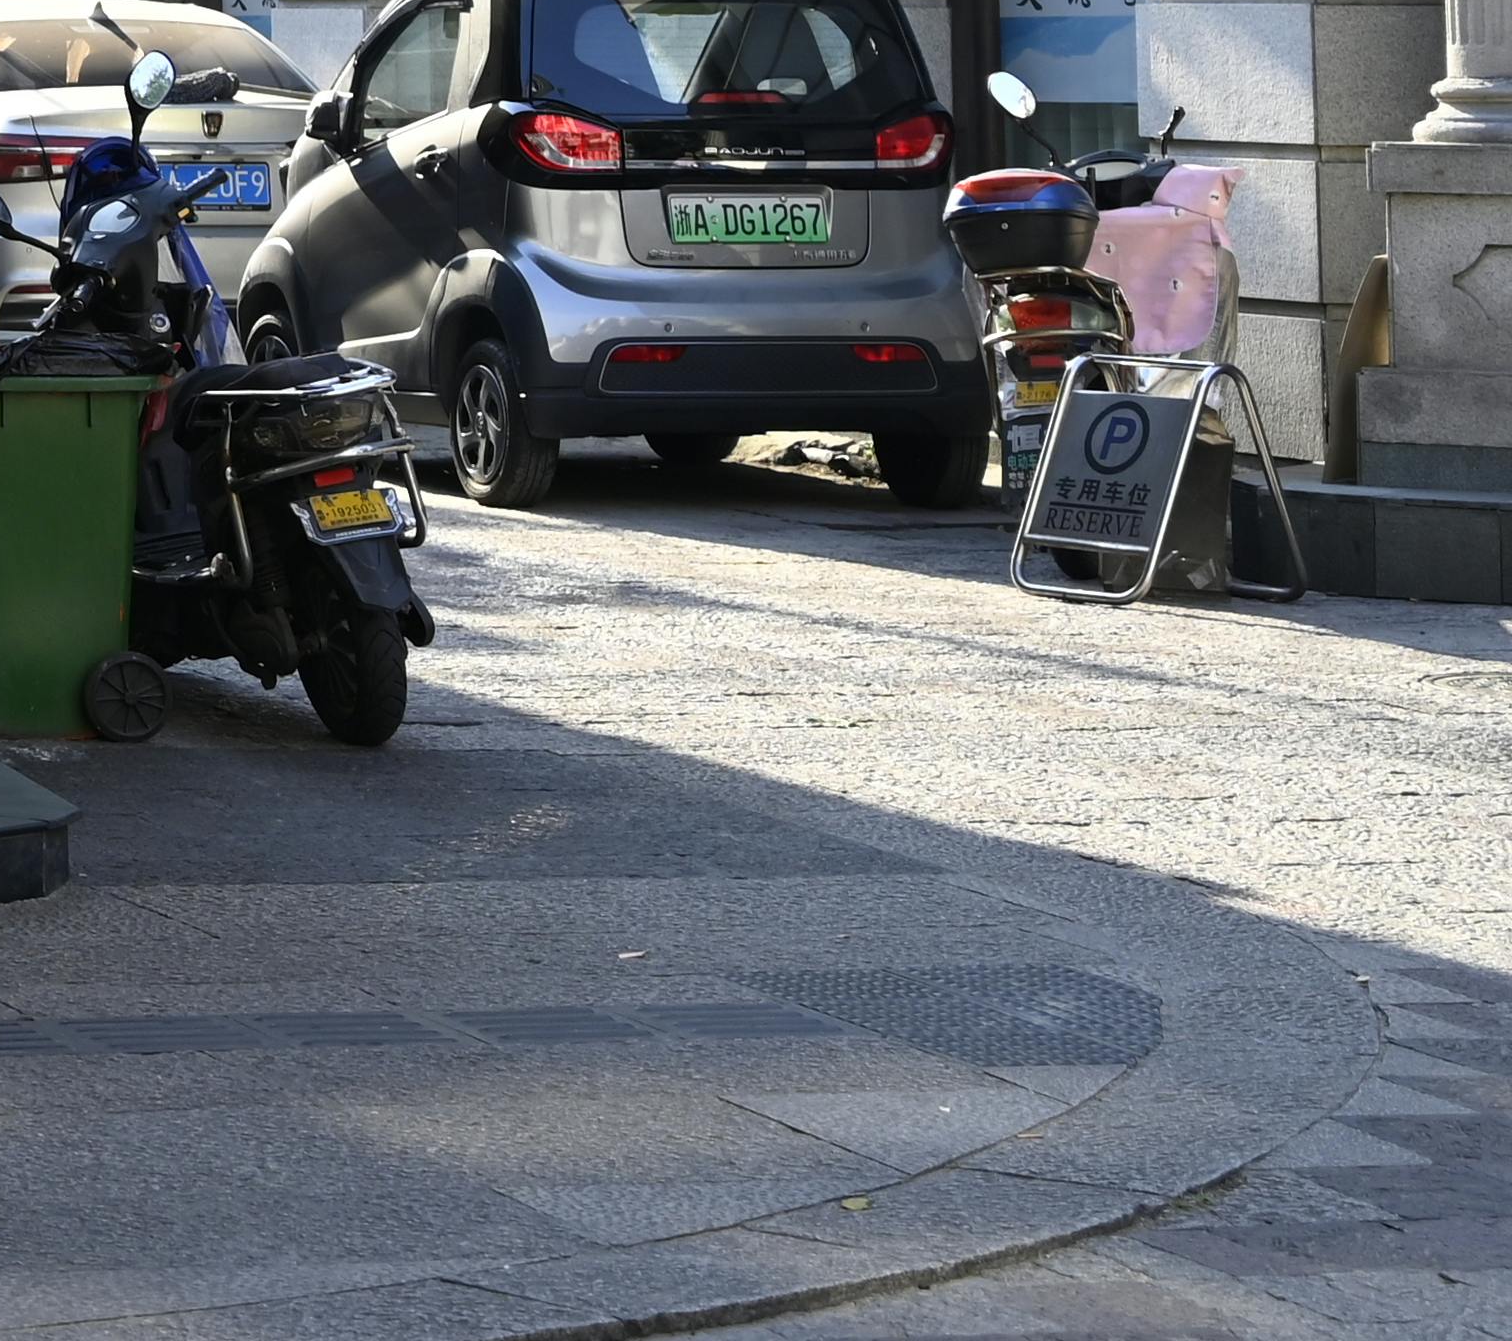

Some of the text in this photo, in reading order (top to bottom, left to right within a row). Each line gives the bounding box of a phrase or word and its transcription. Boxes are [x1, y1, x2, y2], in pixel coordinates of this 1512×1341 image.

[1006, 423, 1048, 454] 恒
[1099, 415, 1138, 461] P
[1055, 476, 1153, 507] 专用车位
[1043, 507, 1144, 538] RESERVE
